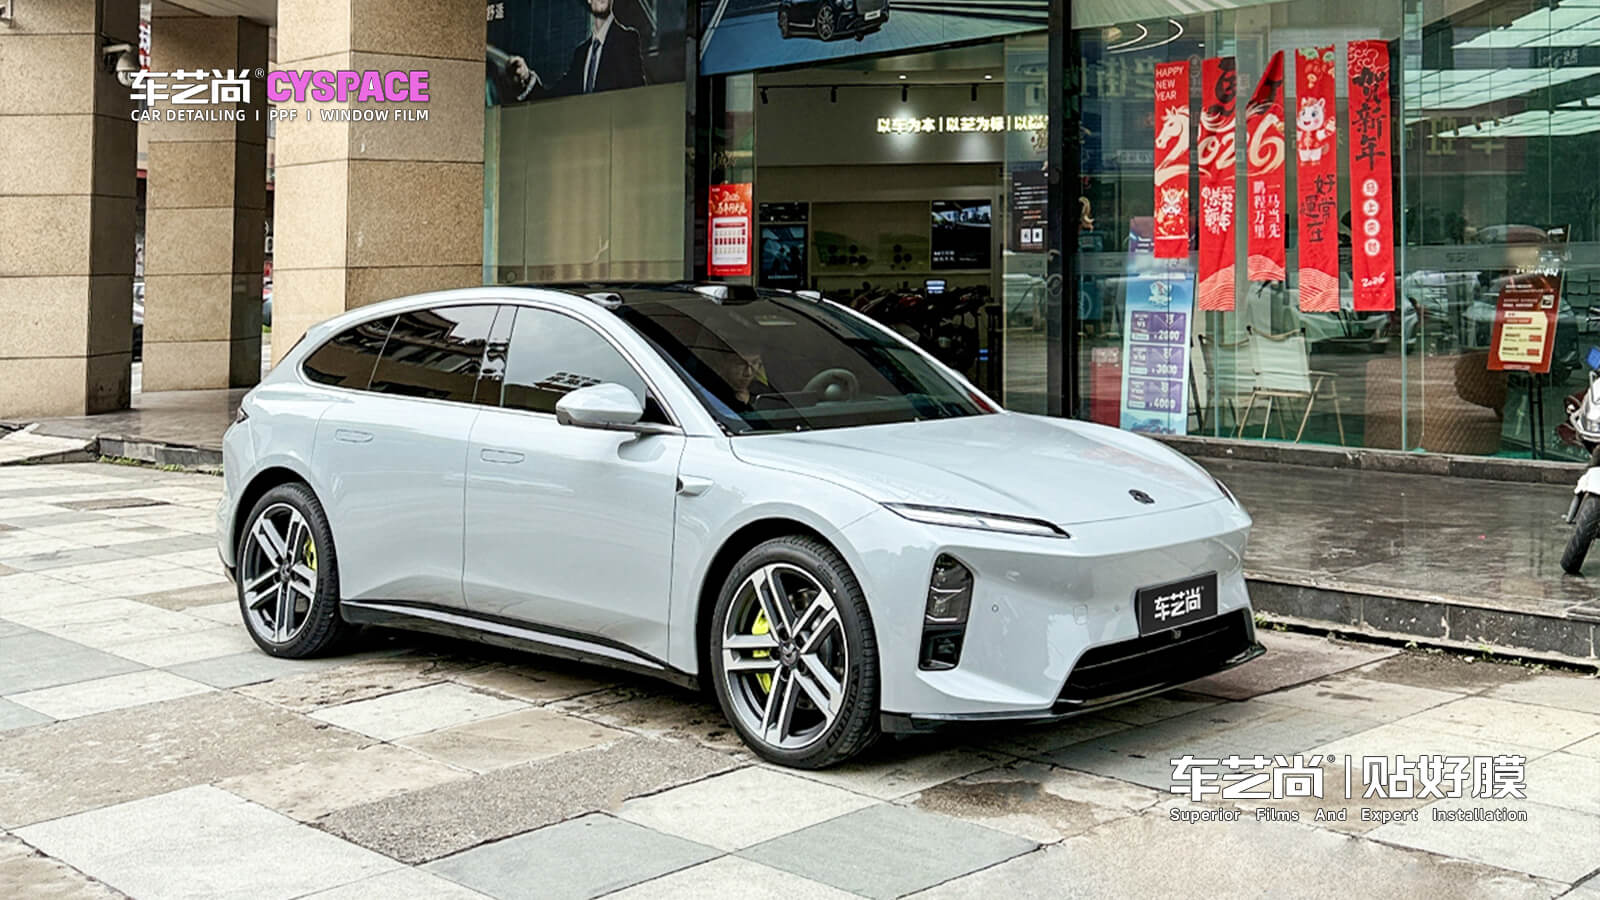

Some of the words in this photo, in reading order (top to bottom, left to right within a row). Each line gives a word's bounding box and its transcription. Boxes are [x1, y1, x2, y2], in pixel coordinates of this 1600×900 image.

[1155, 66, 1184, 77] HAPPY
[1155, 80, 1176, 90] NEW
[1155, 91, 1177, 101] YEAR
[1352, 67, 1387, 172] 贺新年
[1253, 180, 1266, 238] 鹏程万里
[1267, 183, 1282, 238] 一马当先
[1154, 586, 1202, 621] 车艺尚
